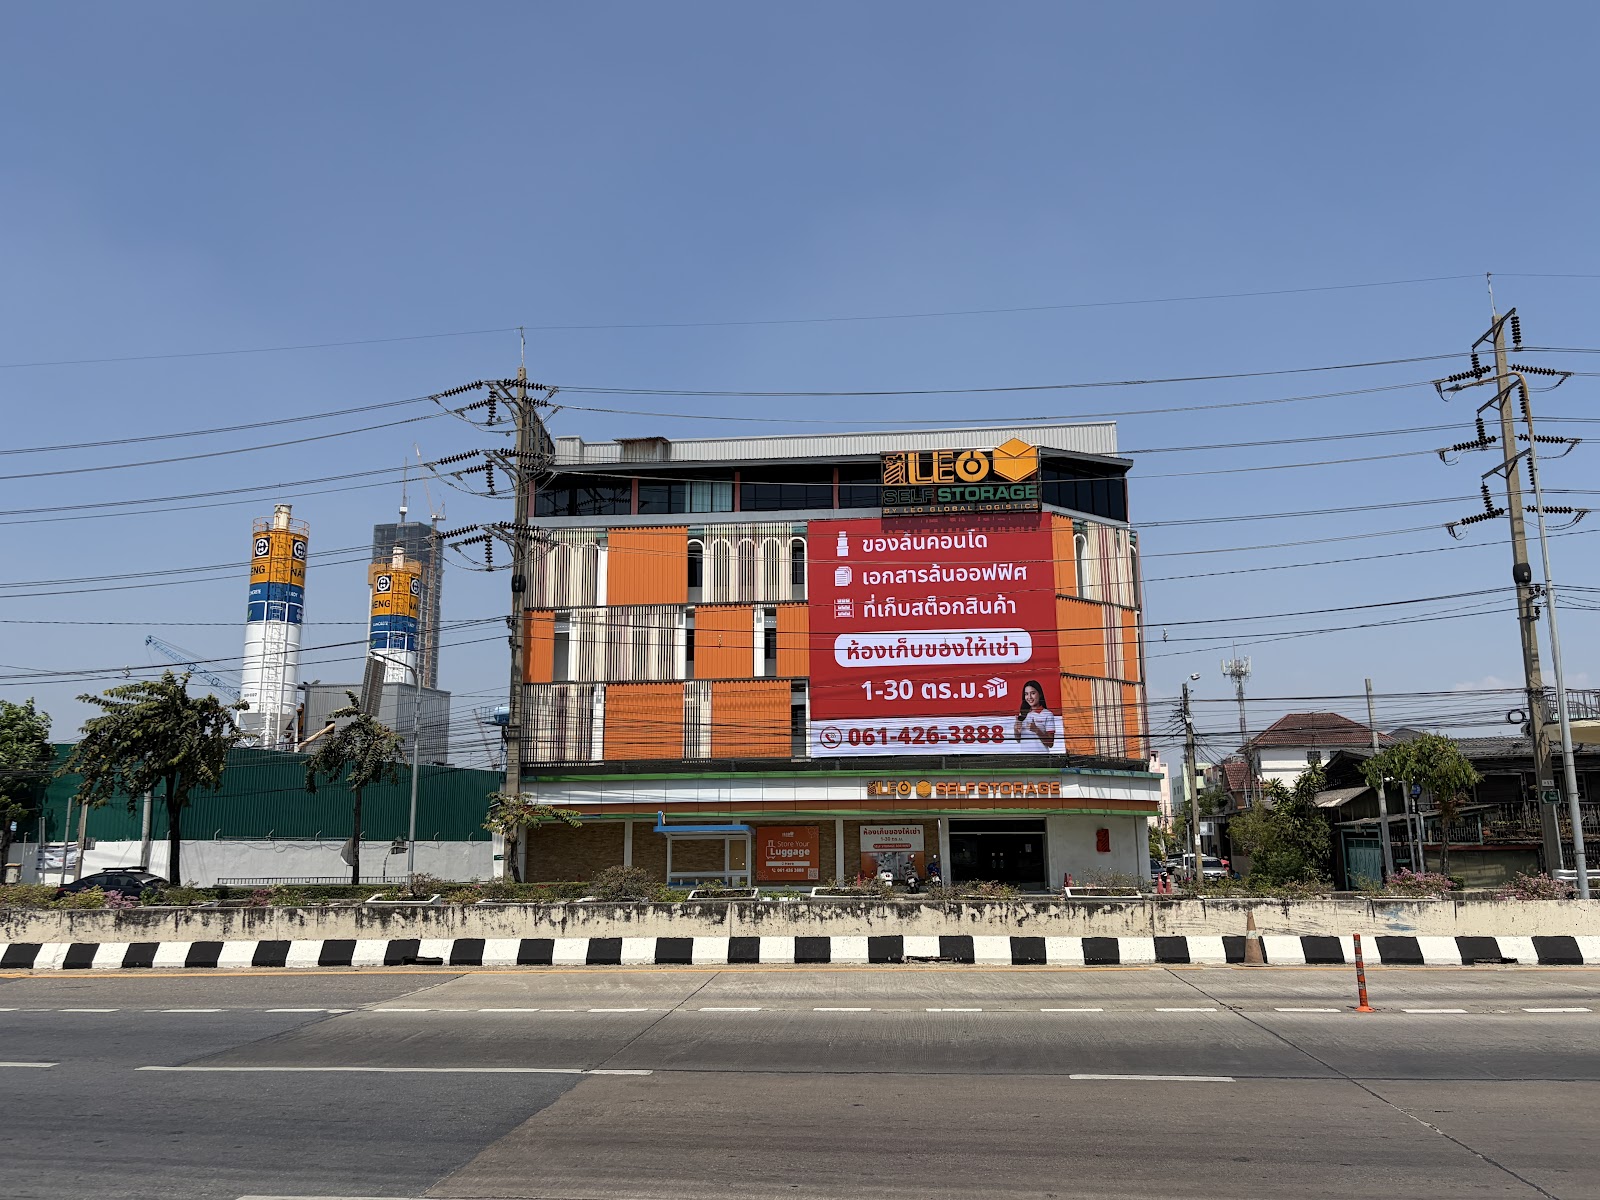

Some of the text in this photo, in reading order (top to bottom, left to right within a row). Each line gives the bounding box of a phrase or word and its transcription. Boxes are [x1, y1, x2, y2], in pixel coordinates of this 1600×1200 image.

[908, 450, 989, 484] LEO
[883, 484, 1038, 505] SELF STORAGE
[979, 503, 1039, 511] LOGISTICS
[863, 563, 1028, 585] เอกสารล้นออฟฟิศ
[863, 594, 1017, 618] ที่เก็บสต็อกสินค้า
[847, 636, 1019, 660] ห้องเก็บของให้เช่า
[861, 679, 984, 701] 1-30 ตร.ม.
[848, 725, 1005, 746] 061-426-3888
[877, 780, 1061, 796] LEO SELF STORAGE
[770, 848, 810, 858] Luggage
